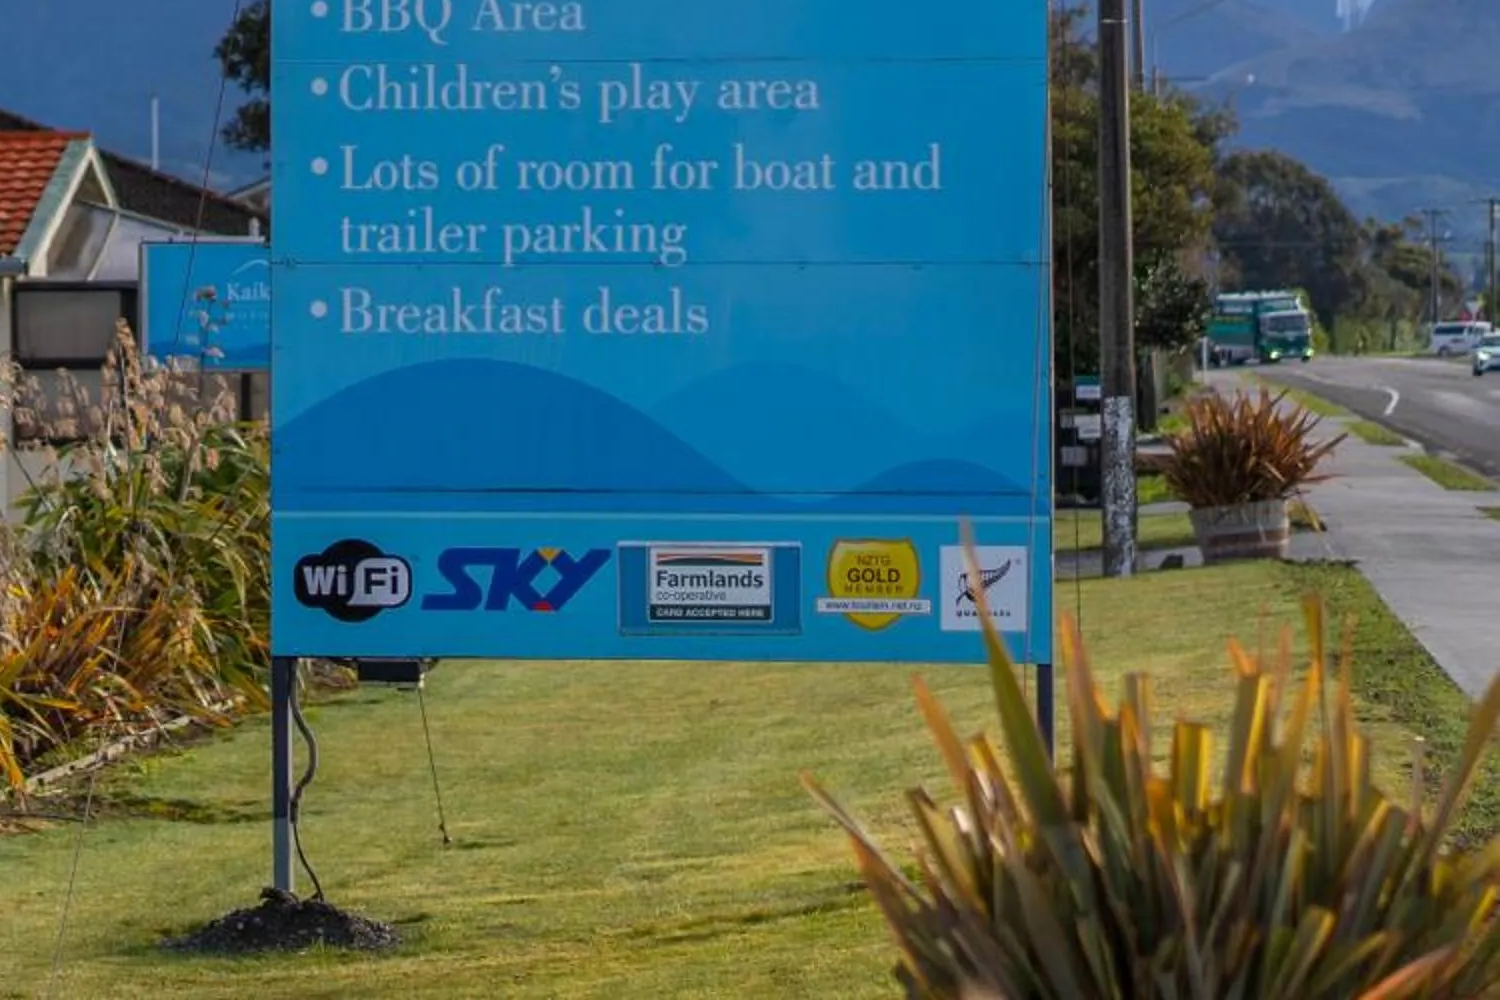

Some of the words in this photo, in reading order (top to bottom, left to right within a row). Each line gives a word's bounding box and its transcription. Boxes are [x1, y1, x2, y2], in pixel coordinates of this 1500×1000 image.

[339, 64, 582, 112] Children's
[600, 63, 699, 123] play
[719, 80, 820, 112] area
[341, 145, 440, 191] Lots
[456, 145, 506, 191] of
[518, 162, 636, 191] room
[652, 144, 720, 191] for
[735, 144, 835, 191] boat
[853, 144, 942, 191] and
[341, 206, 486, 254] trailer
[502, 207, 688, 266] parking
[341, 288, 566, 335] Breakfast
[583, 287, 710, 335] deals
[302, 564, 400, 596] WiFi
[421, 548, 612, 611] SKY
[656, 569, 764, 588] Farmlands
[847, 567, 901, 583] GOLD
